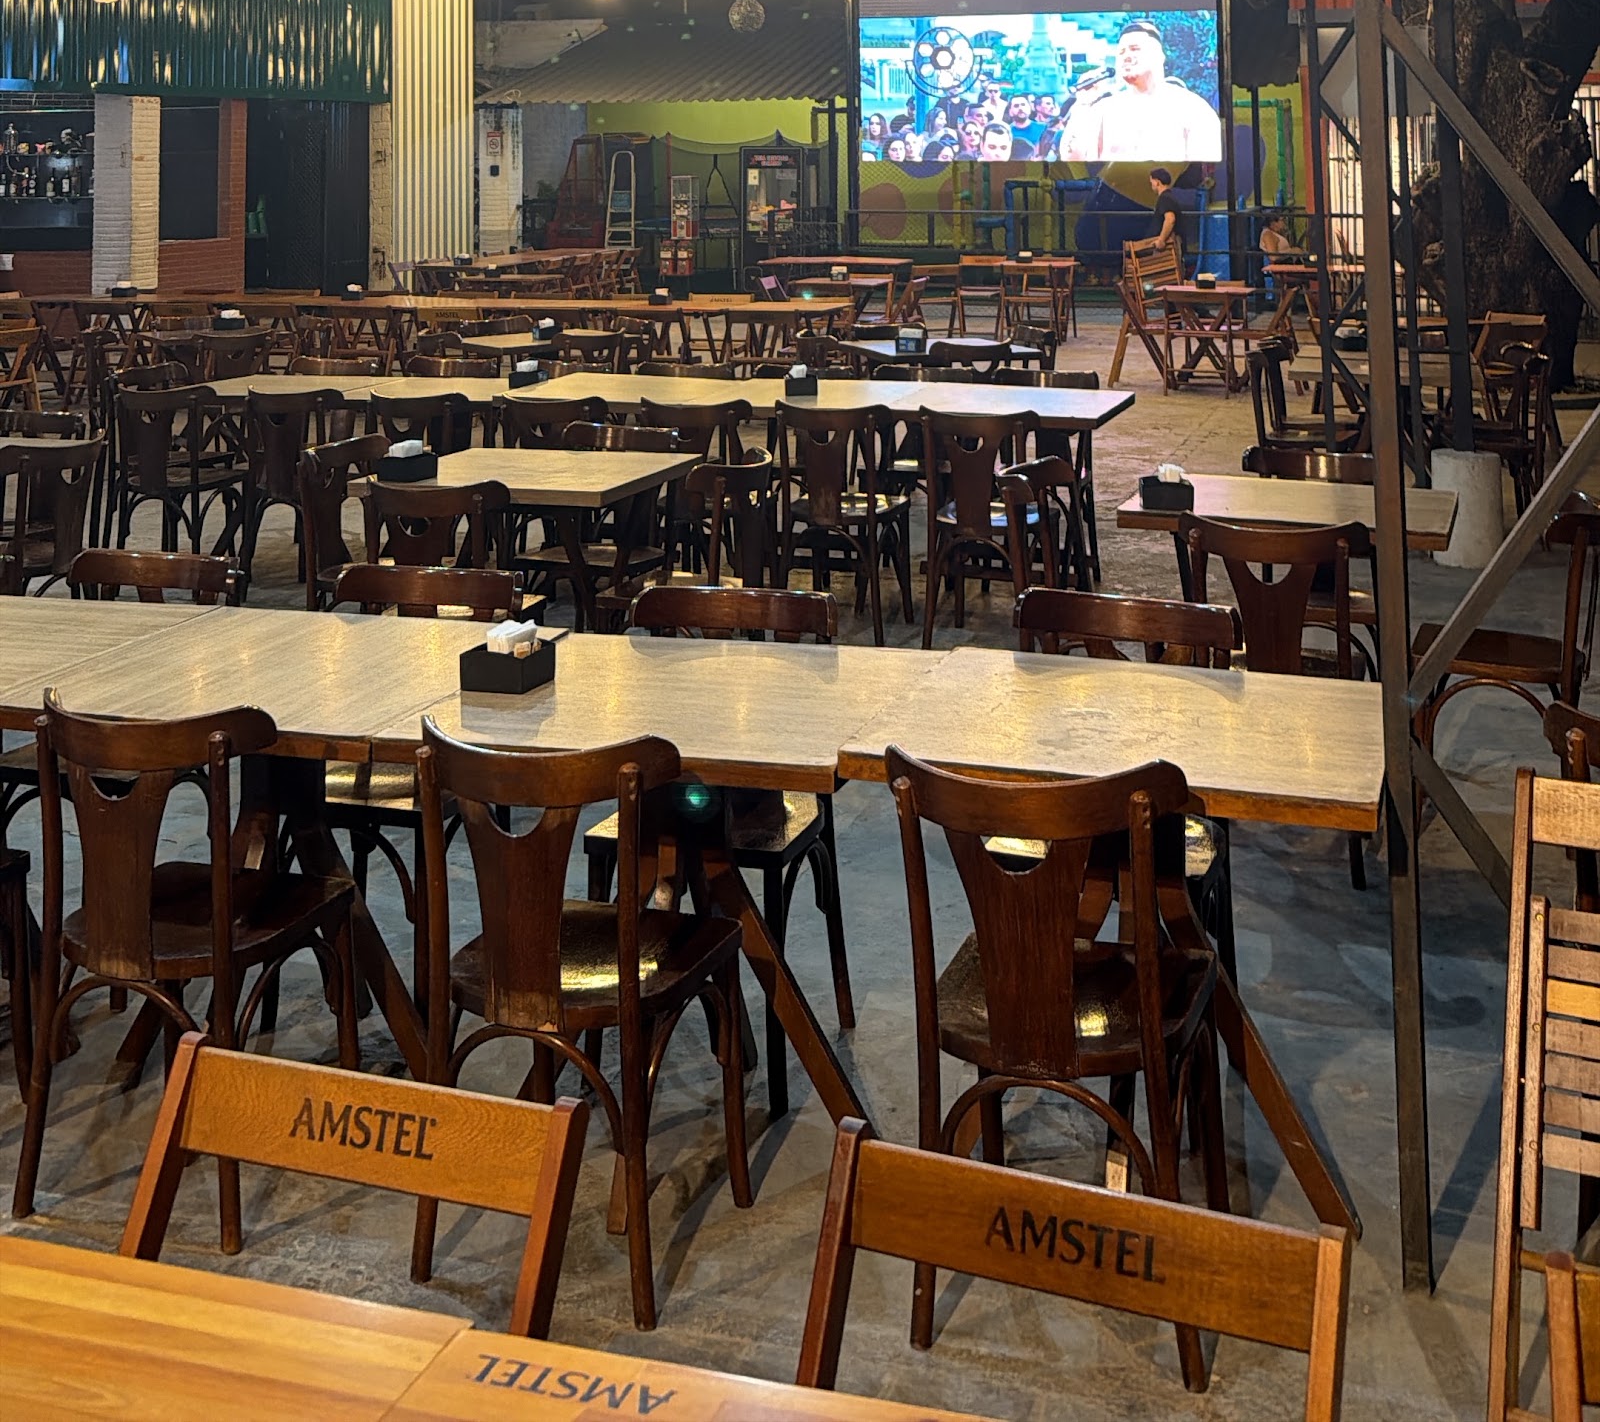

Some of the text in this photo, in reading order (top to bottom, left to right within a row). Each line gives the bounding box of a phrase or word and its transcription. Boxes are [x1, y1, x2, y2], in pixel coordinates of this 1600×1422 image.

[289, 1097, 436, 1160] AMSTEL
[984, 1206, 1166, 1284] AMSTEL
[472, 1353, 678, 1415] AMSTEL
